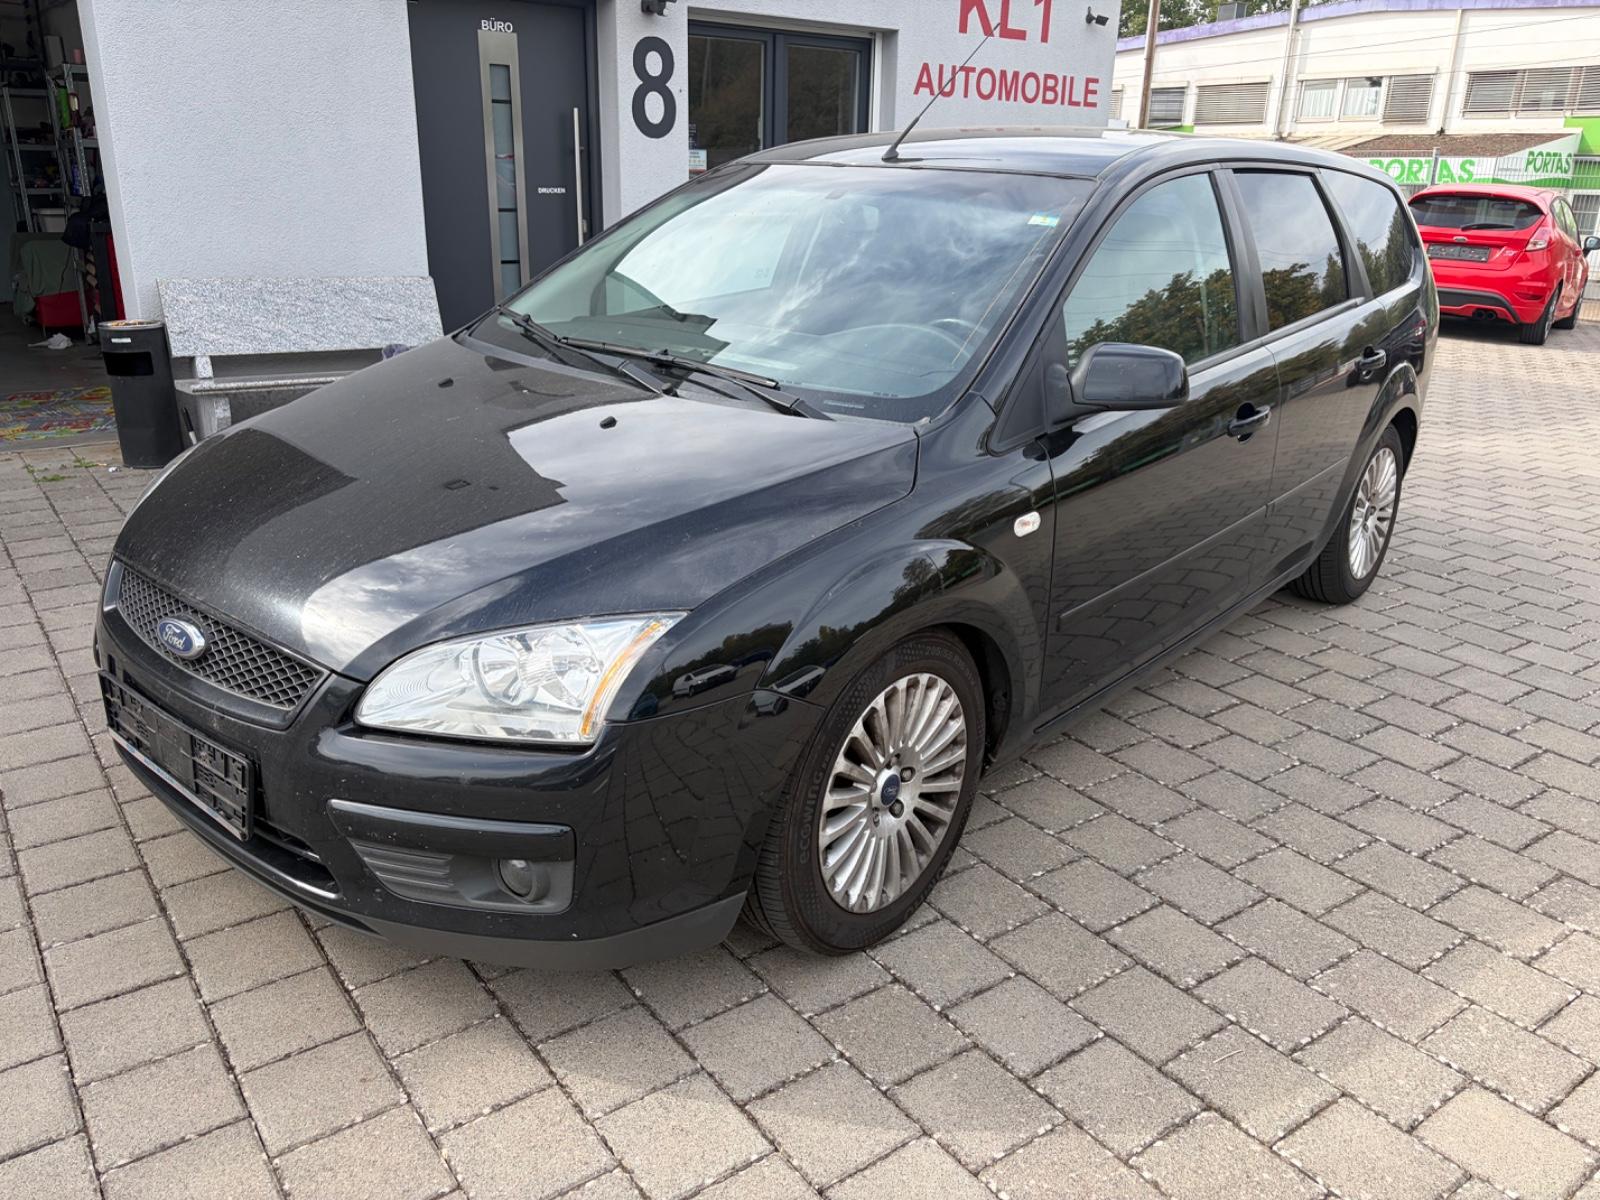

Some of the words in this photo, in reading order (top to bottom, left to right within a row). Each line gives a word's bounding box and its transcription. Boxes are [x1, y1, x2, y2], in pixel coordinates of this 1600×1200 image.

[481, 17, 514, 33] BÜRO
[958, 0, 1052, 43] KL1
[632, 36, 677, 139] 8
[913, 62, 1100, 108] AUTOMOBILE
[1524, 150, 1573, 175] PORTAS
[163, 623, 187, 651] Ford
